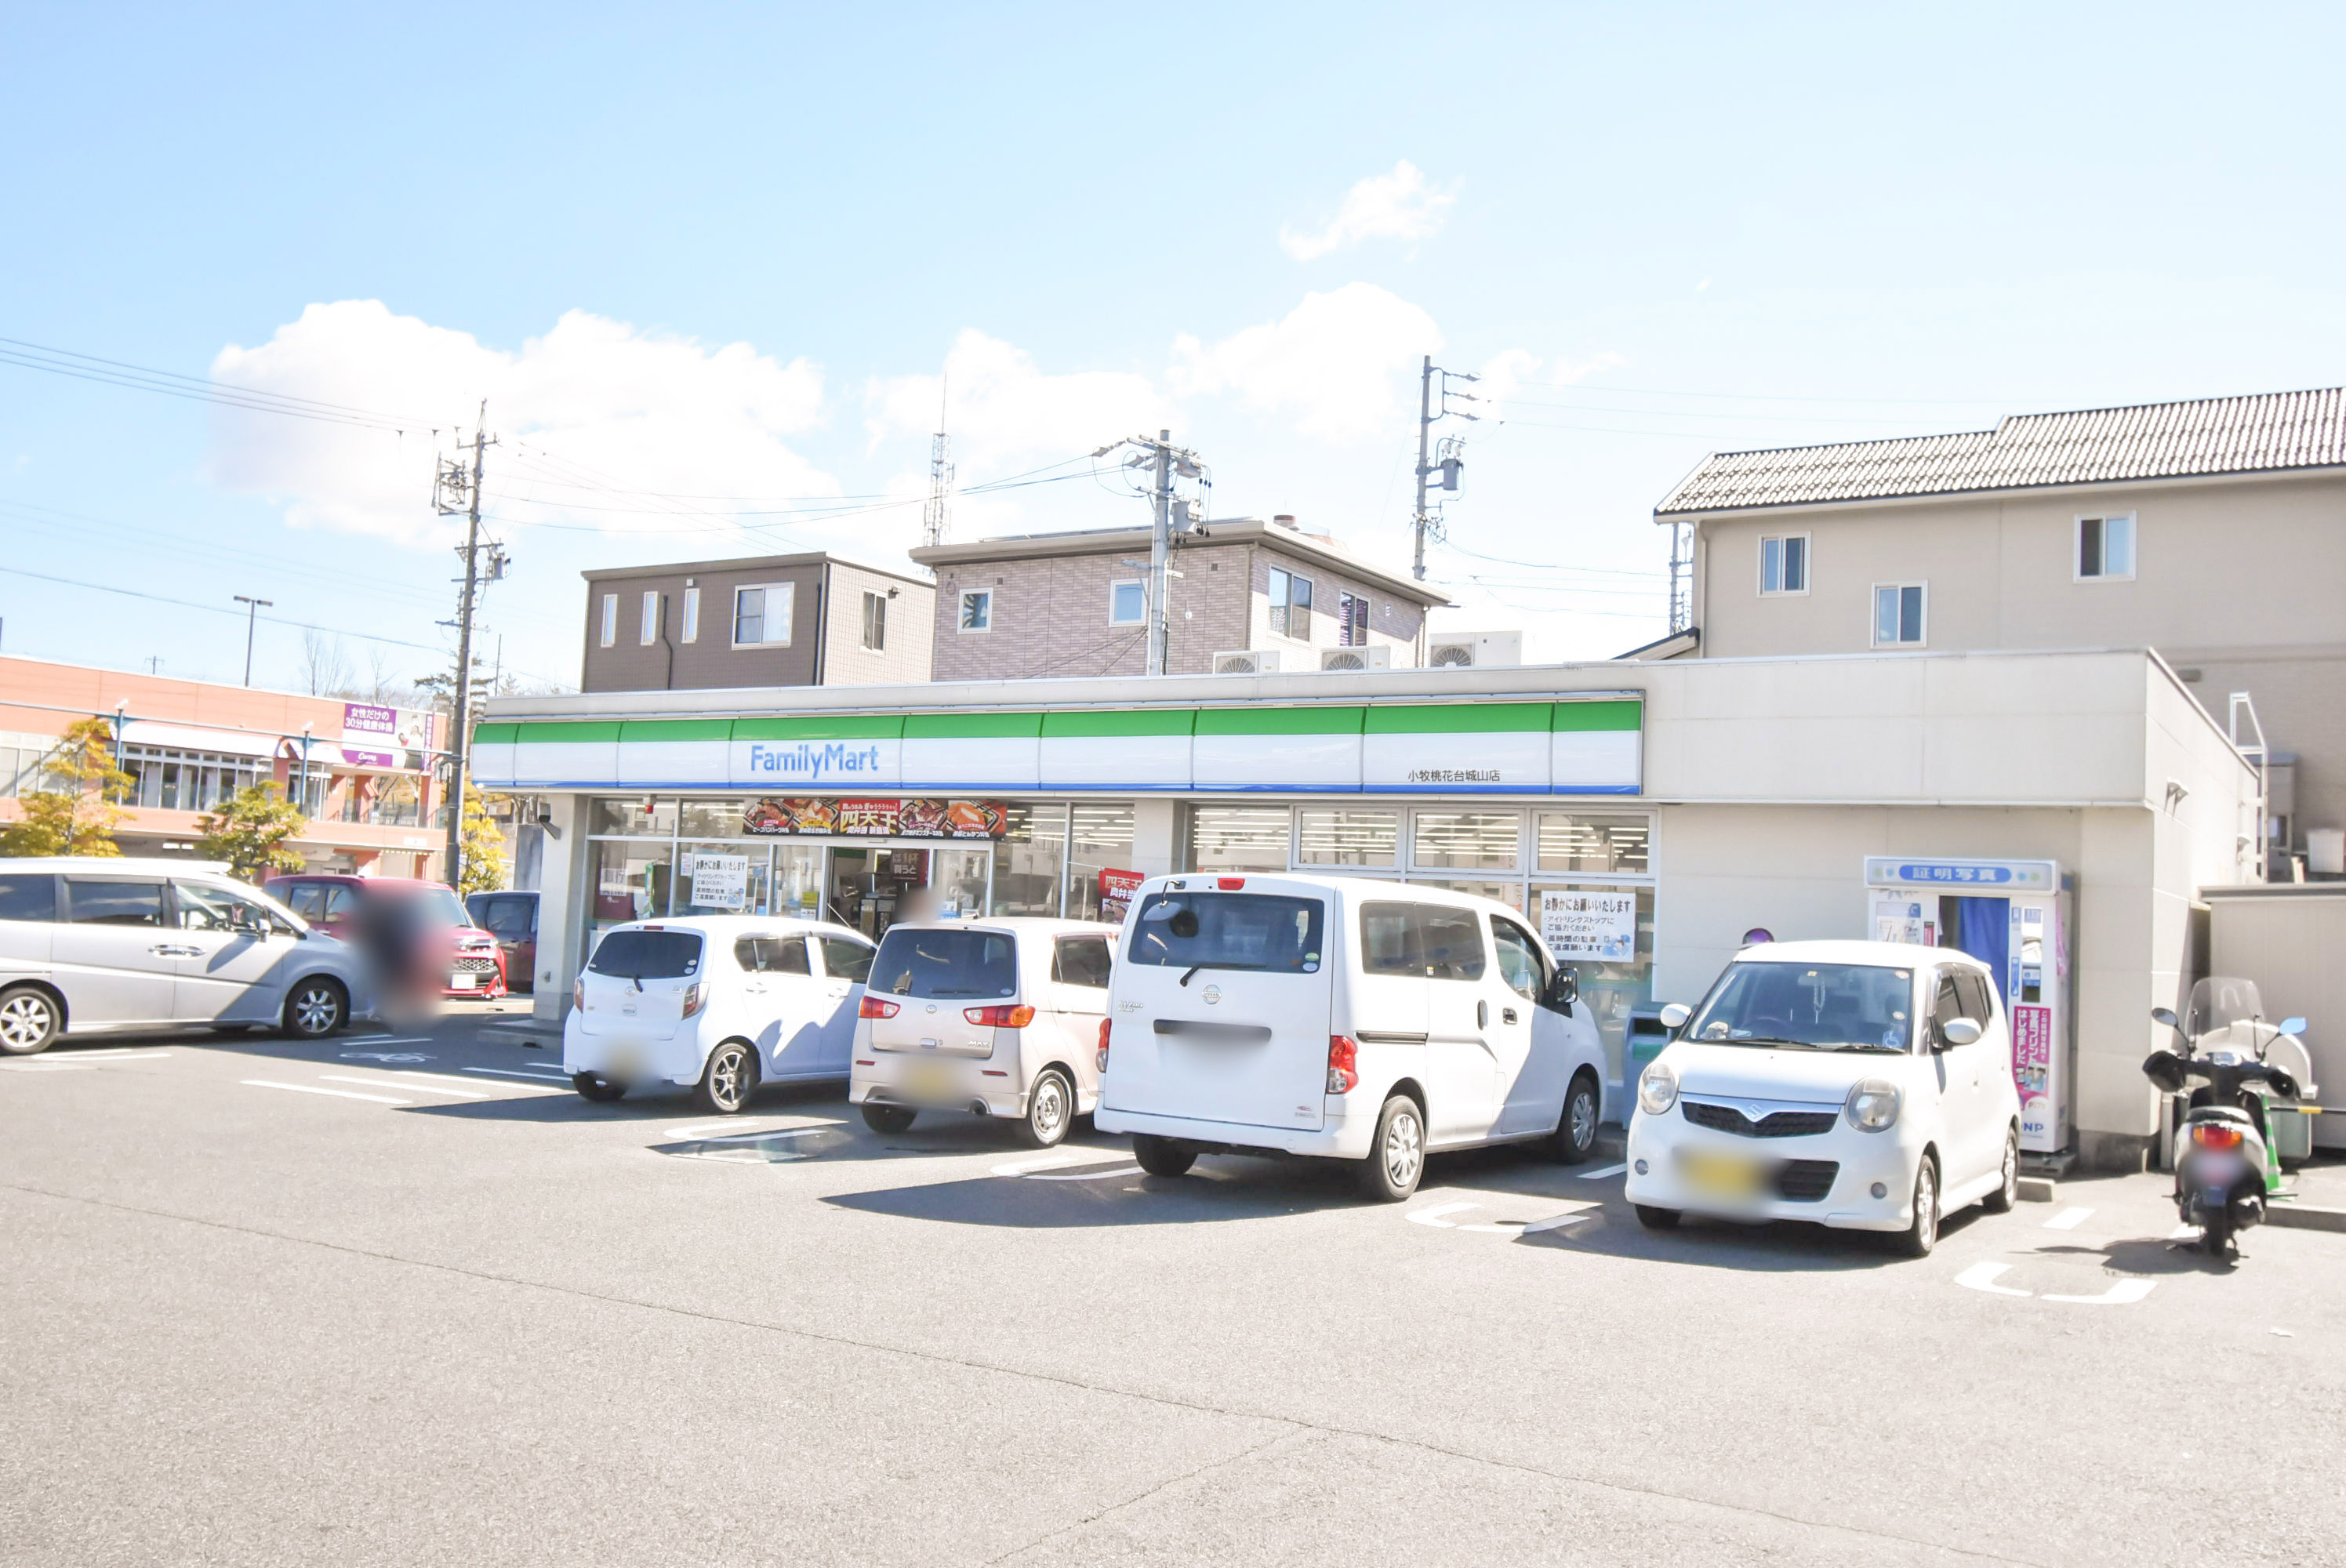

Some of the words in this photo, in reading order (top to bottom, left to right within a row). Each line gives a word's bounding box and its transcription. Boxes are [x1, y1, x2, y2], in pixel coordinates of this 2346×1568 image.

[351, 707, 390, 720] 女性だけの
[345, 717, 394, 732] 30分健康体操
[750, 743, 879, 779] FamilyMart
[1407, 769, 1501, 782] 小牧桃花台城山店
[840, 810, 899, 834] 四天王
[1912, 866, 1997, 881] 証明写真
[1545, 897, 1631, 913] お静かにお願いいたします
[2016, 1009, 2028, 1065] はじめました
[2021, 1122, 2044, 1132] NP
